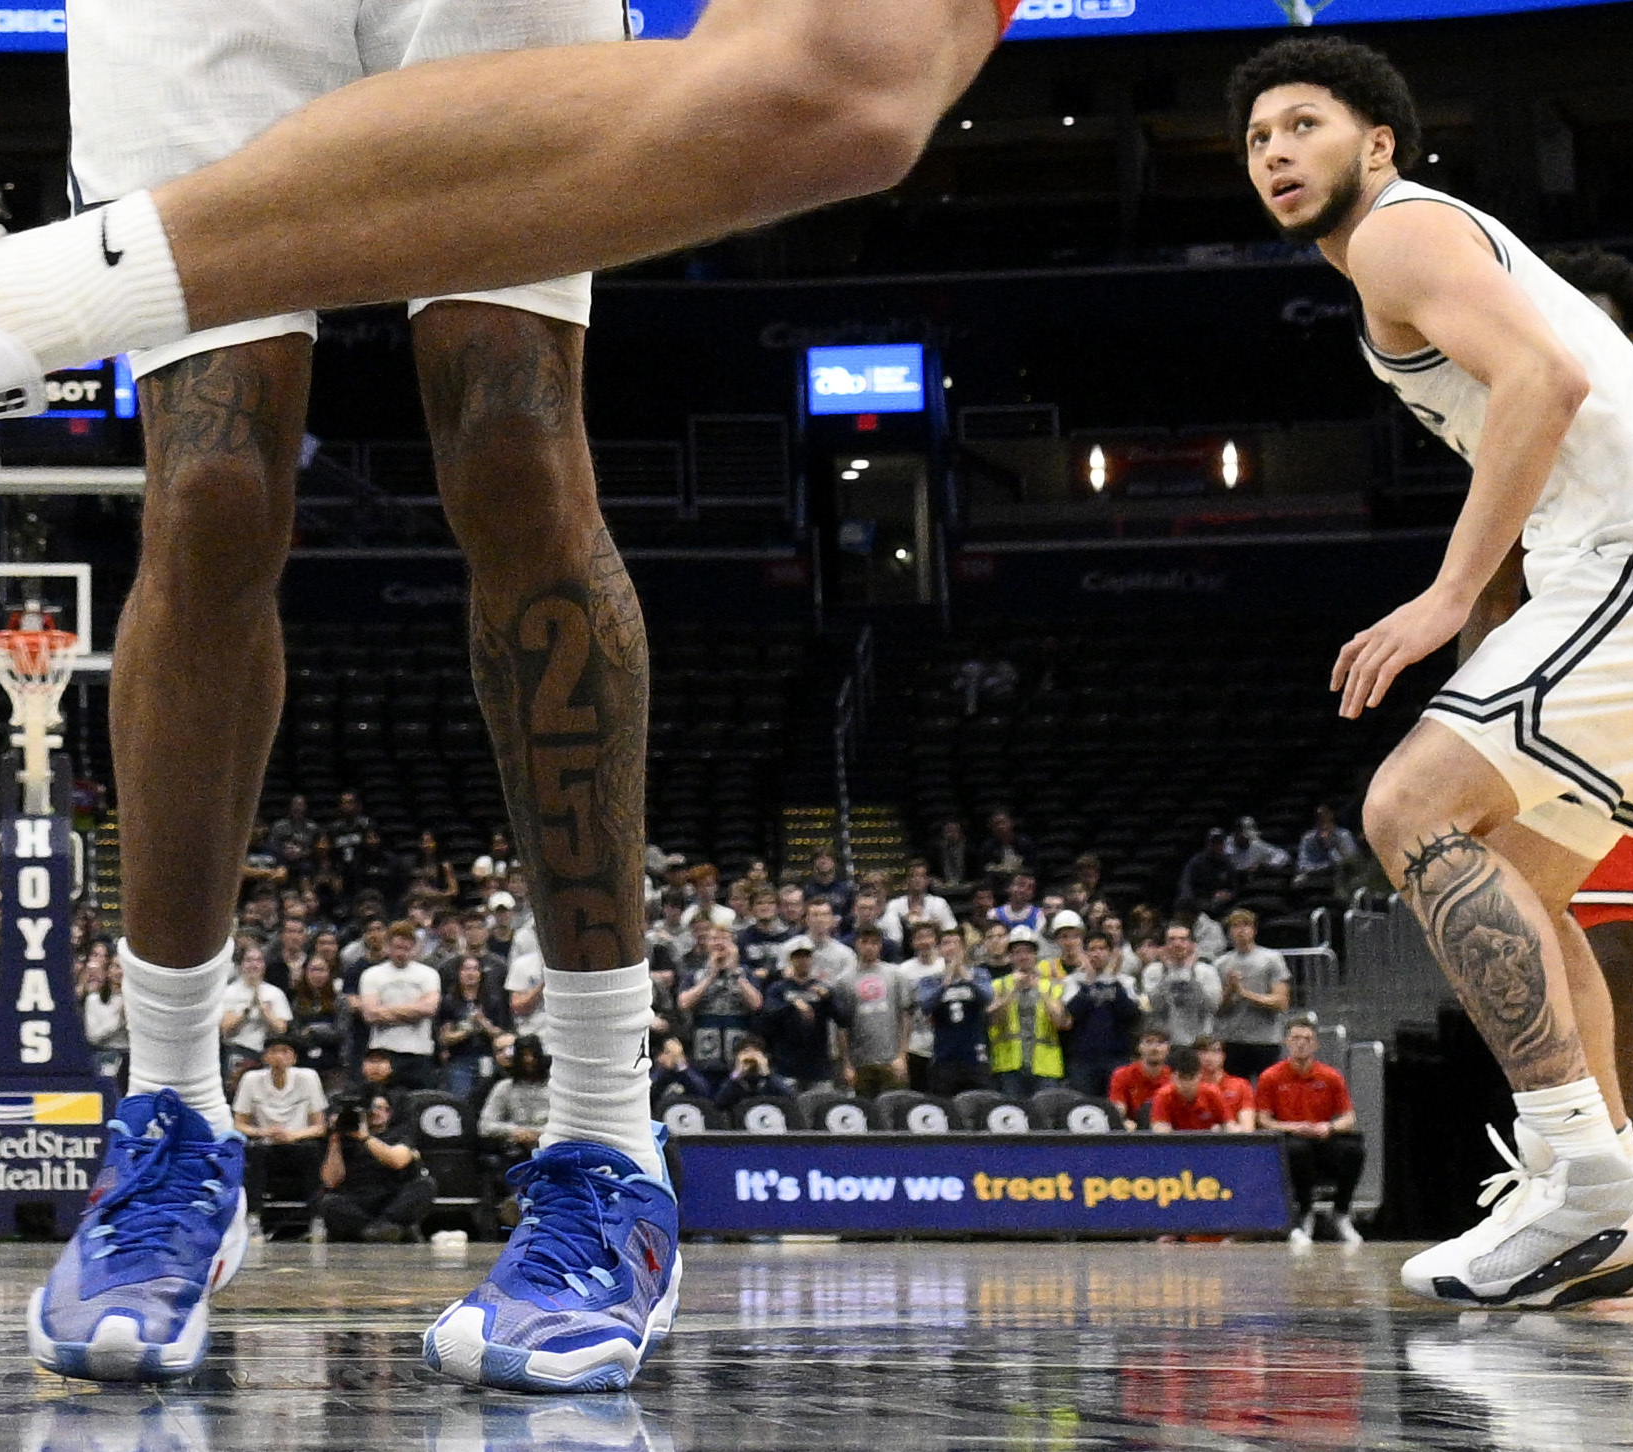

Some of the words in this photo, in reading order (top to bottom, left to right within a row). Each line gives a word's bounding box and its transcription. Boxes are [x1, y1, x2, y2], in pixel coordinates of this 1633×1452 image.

[14, 817, 55, 1064] HOYAS
[735, 1169, 801, 1201] It's
[808, 1169, 895, 1202] how
[903, 1176, 964, 1202] we
[973, 1170, 1073, 1202] treat
[1083, 1170, 1233, 1208] people.
